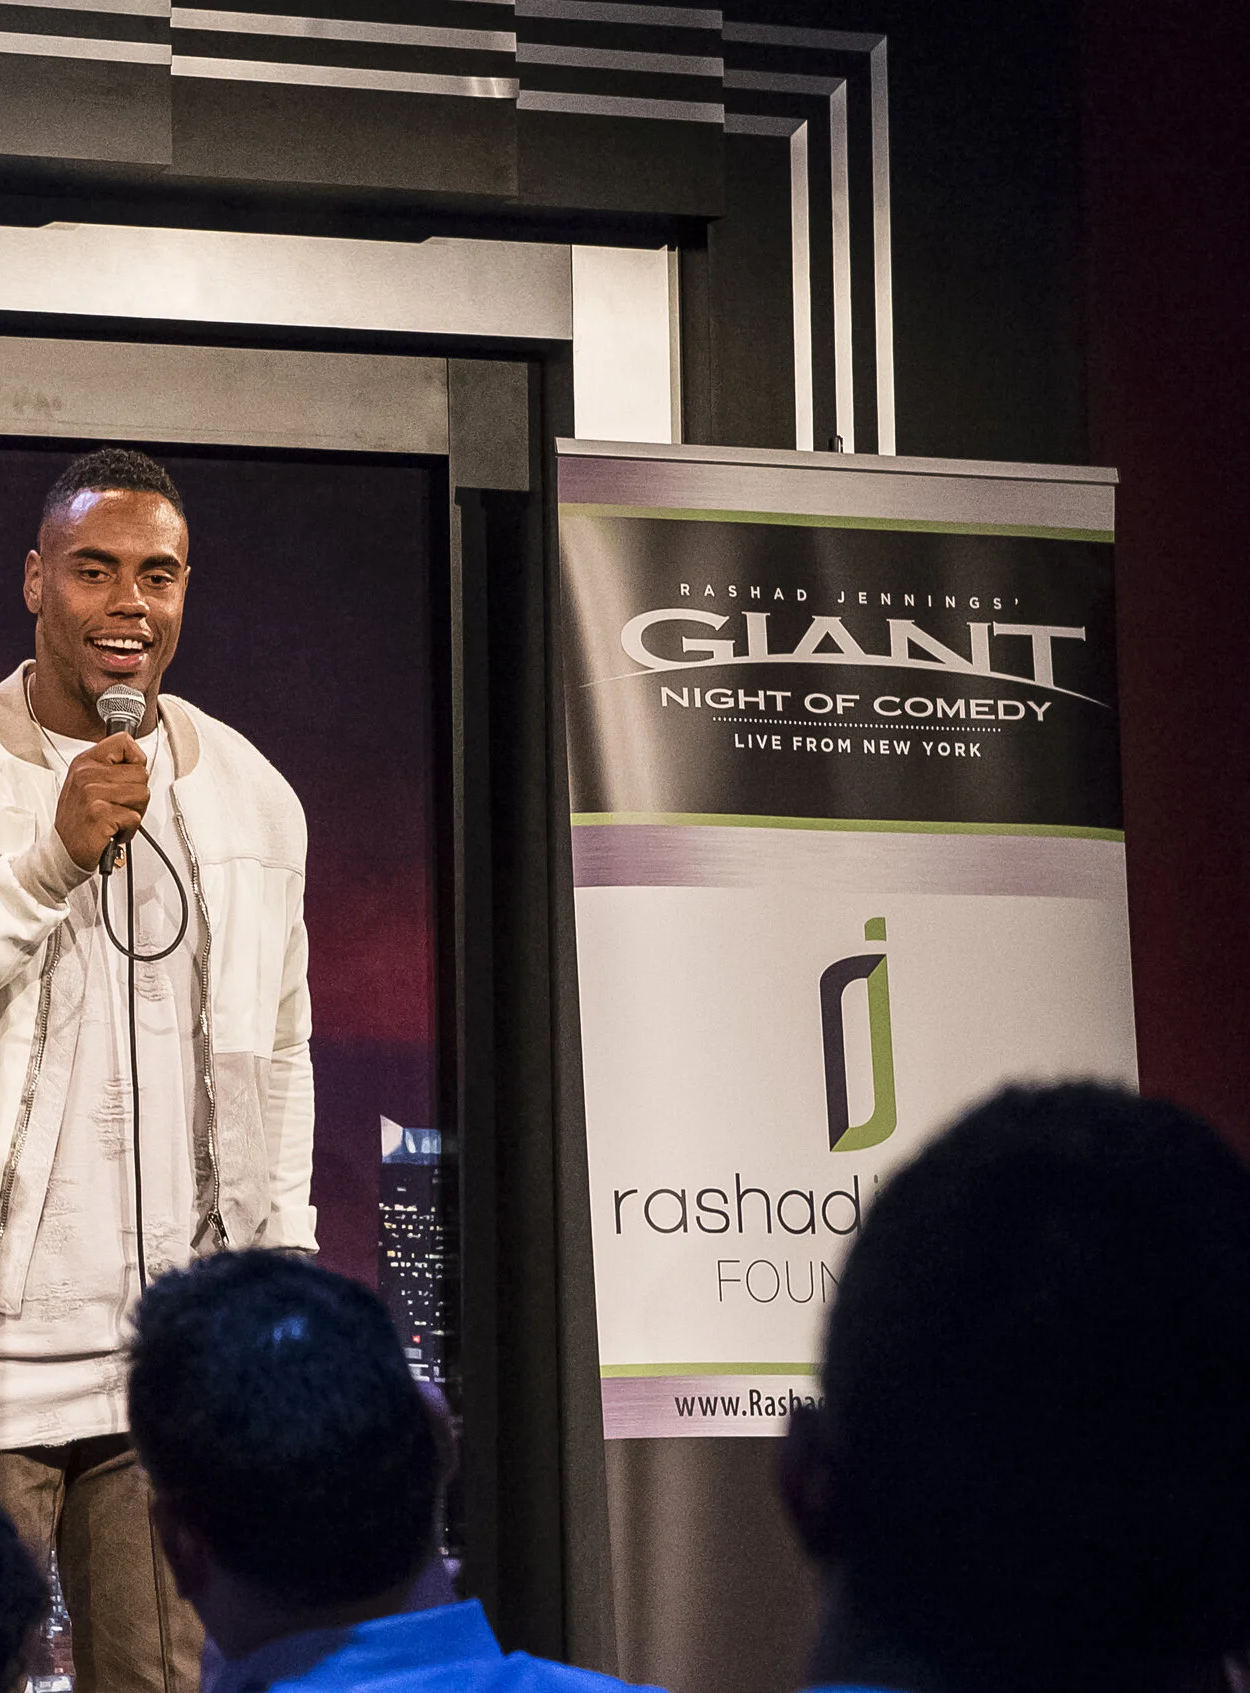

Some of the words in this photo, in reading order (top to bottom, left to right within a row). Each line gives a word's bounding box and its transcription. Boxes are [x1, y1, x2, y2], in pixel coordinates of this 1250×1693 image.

[680, 583, 807, 602] RASHAD
[620, 608, 1086, 690] GIANT
[660, 686, 792, 712] NIGHT
[804, 692, 860, 715] OF
[873, 695, 1052, 722] COMEDY
[734, 733, 782, 751] LIVE
[793, 736, 851, 754] FROM
[863, 739, 911, 756] NEW
[922, 741, 982, 757] YORK
[613, 1172, 862, 1237] rashad
[717, 1259, 840, 1304] FOUN
